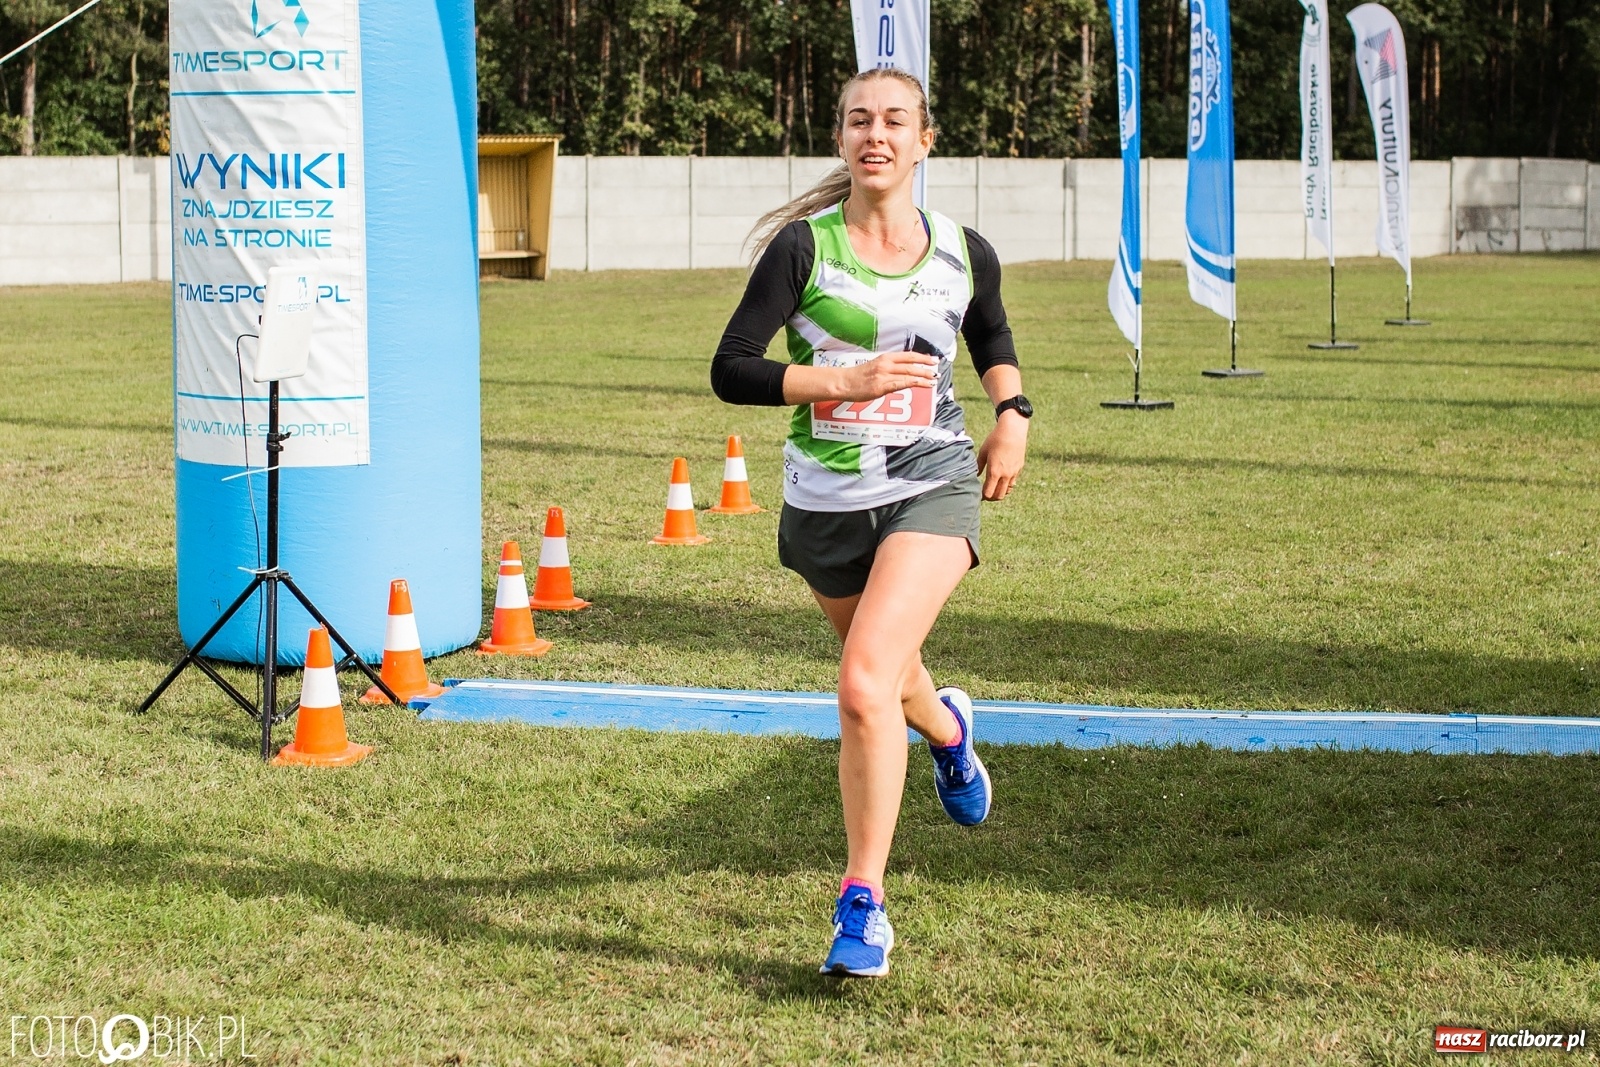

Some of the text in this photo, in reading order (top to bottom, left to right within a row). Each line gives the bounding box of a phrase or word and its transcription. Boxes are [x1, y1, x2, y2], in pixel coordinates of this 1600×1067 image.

[173, 50, 348, 73] TIMESPORT
[176, 153, 346, 190] WYNIKI
[182, 199, 335, 219] ZNAJDZIESZ
[184, 228, 333, 248] NA STRONIE
